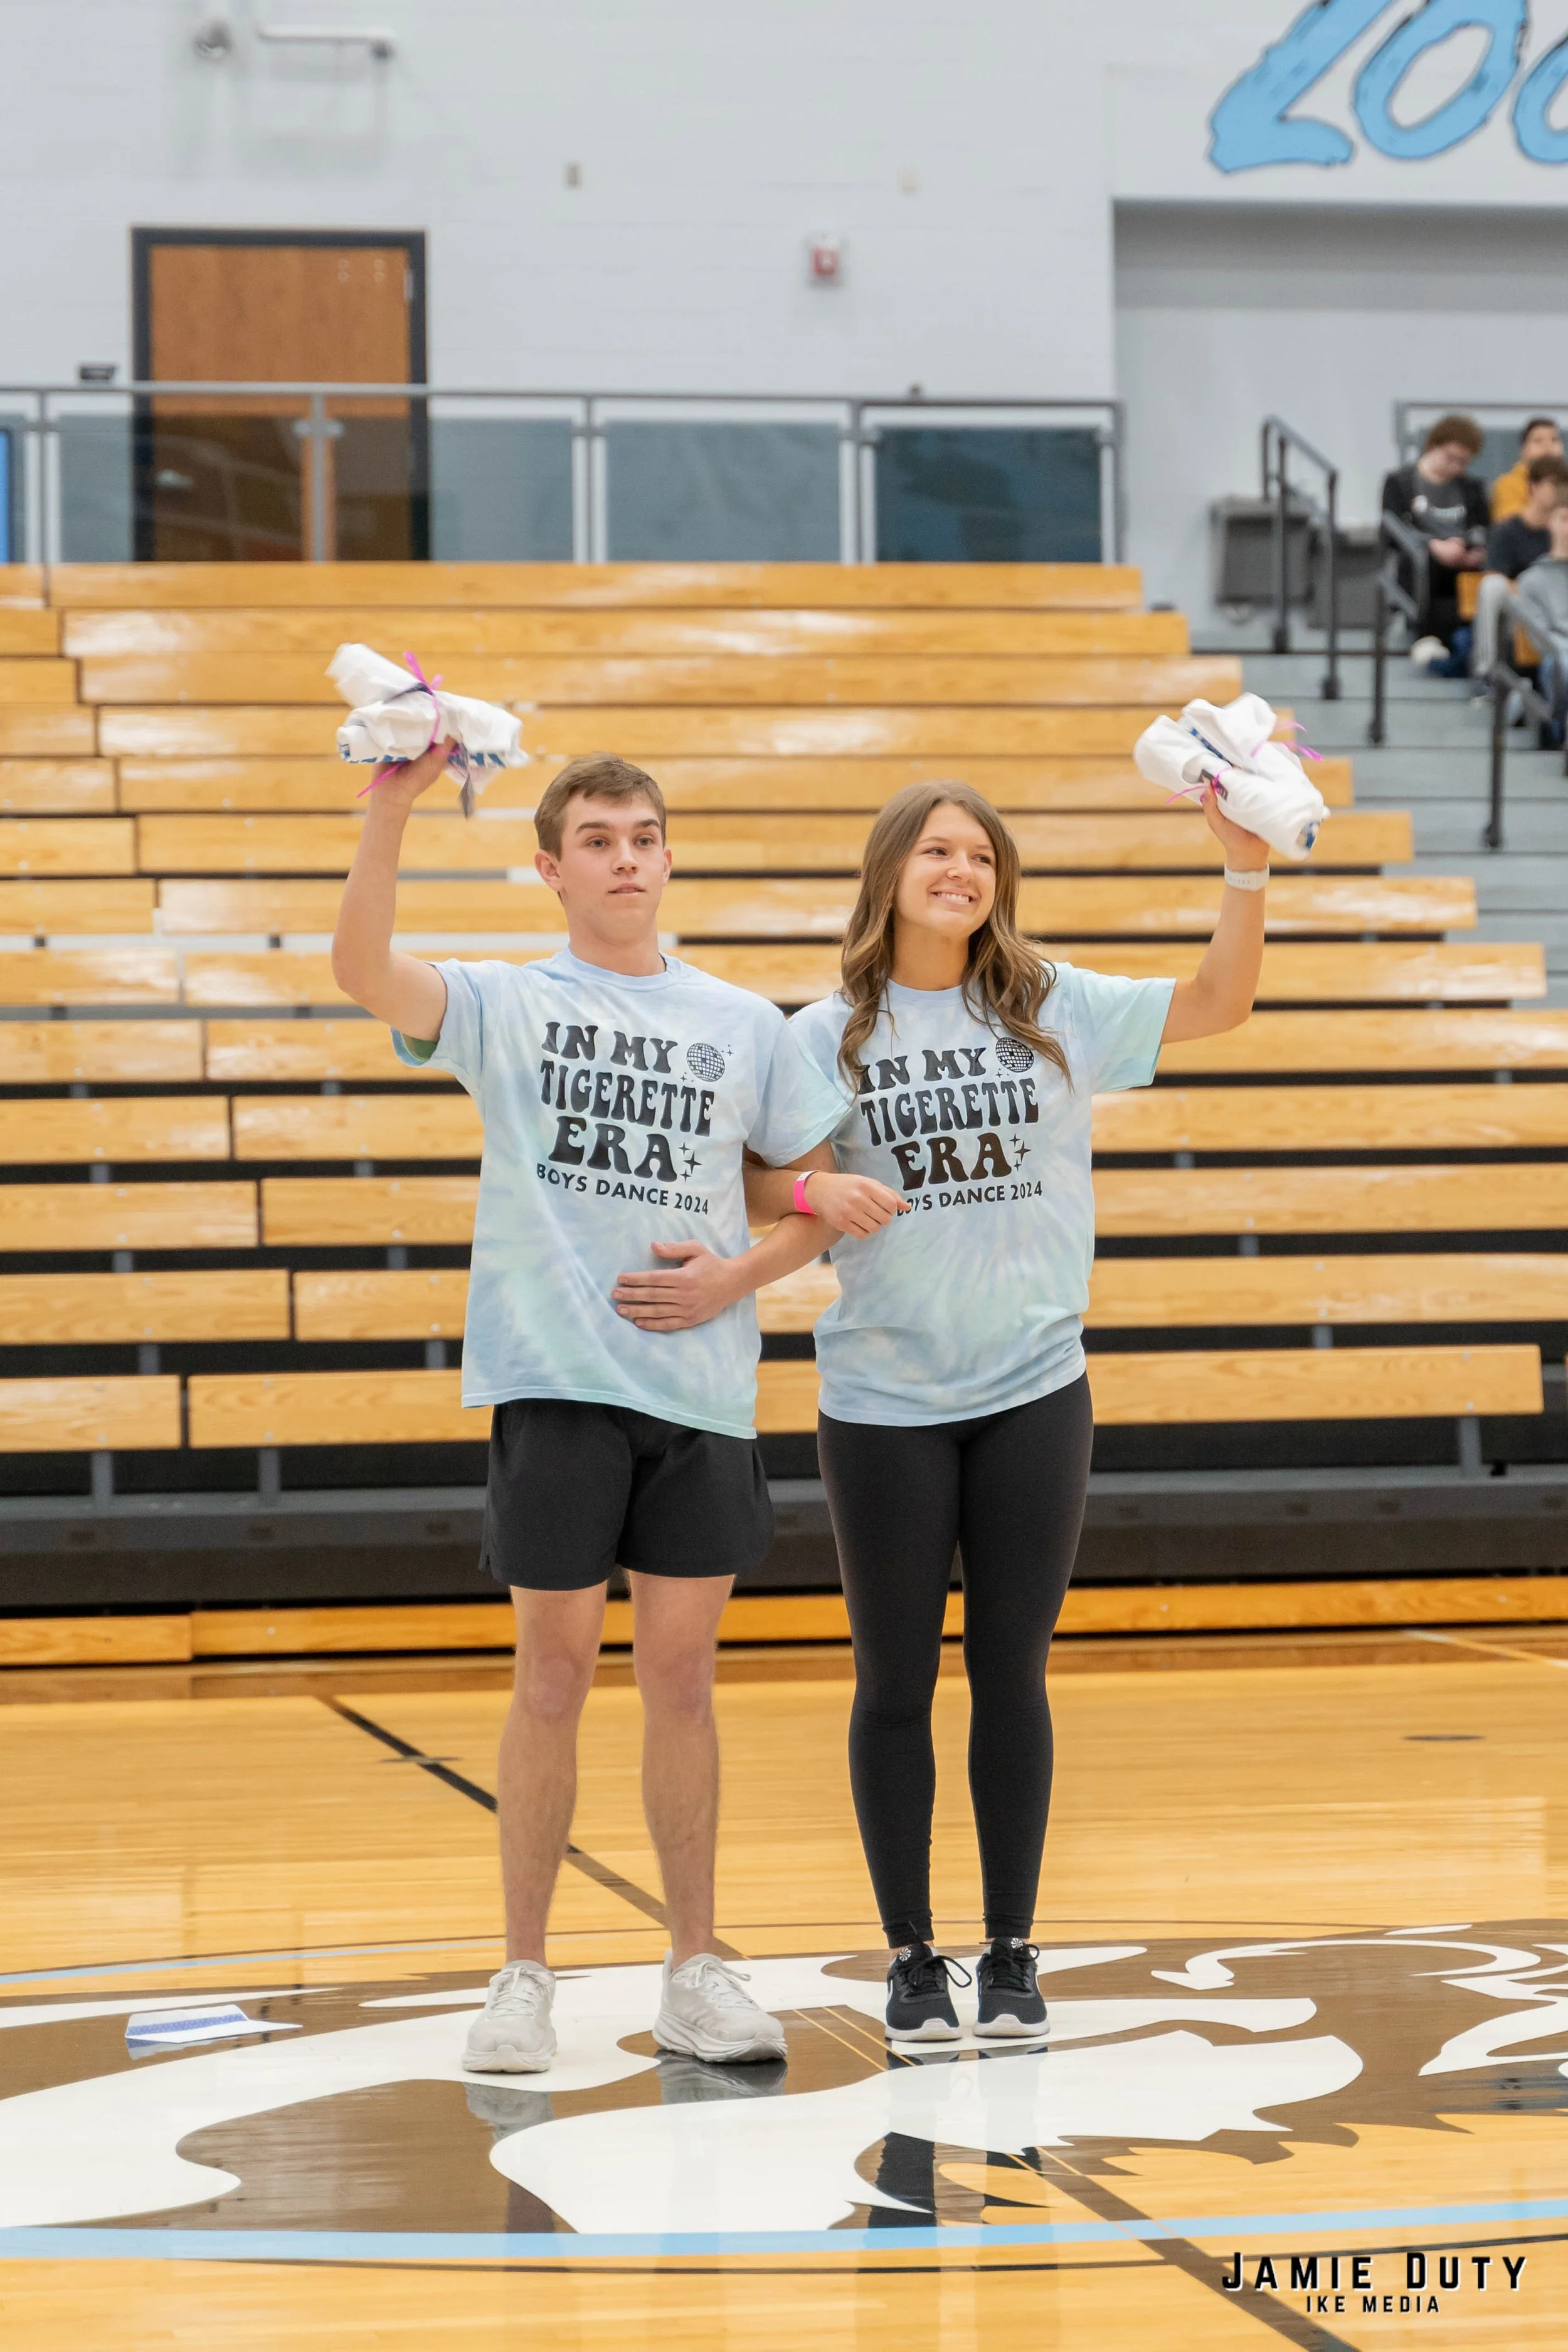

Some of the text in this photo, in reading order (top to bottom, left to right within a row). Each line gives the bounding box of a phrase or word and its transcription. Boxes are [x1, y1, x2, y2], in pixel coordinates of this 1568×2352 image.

[541, 1022, 678, 1074] IN MY
[858, 1047, 987, 1095] IN MY
[540, 1059, 714, 1137] TIGERETTE
[861, 1078, 1039, 1147] TIGERETTE
[548, 1116, 677, 1182] ERA
[891, 1132, 1012, 1191] ERA
[536, 1163, 709, 1215] BOYS DANCE 2024
[939, 1185, 1005, 1208] DANCE
[1011, 1181, 1042, 1200] 2024
